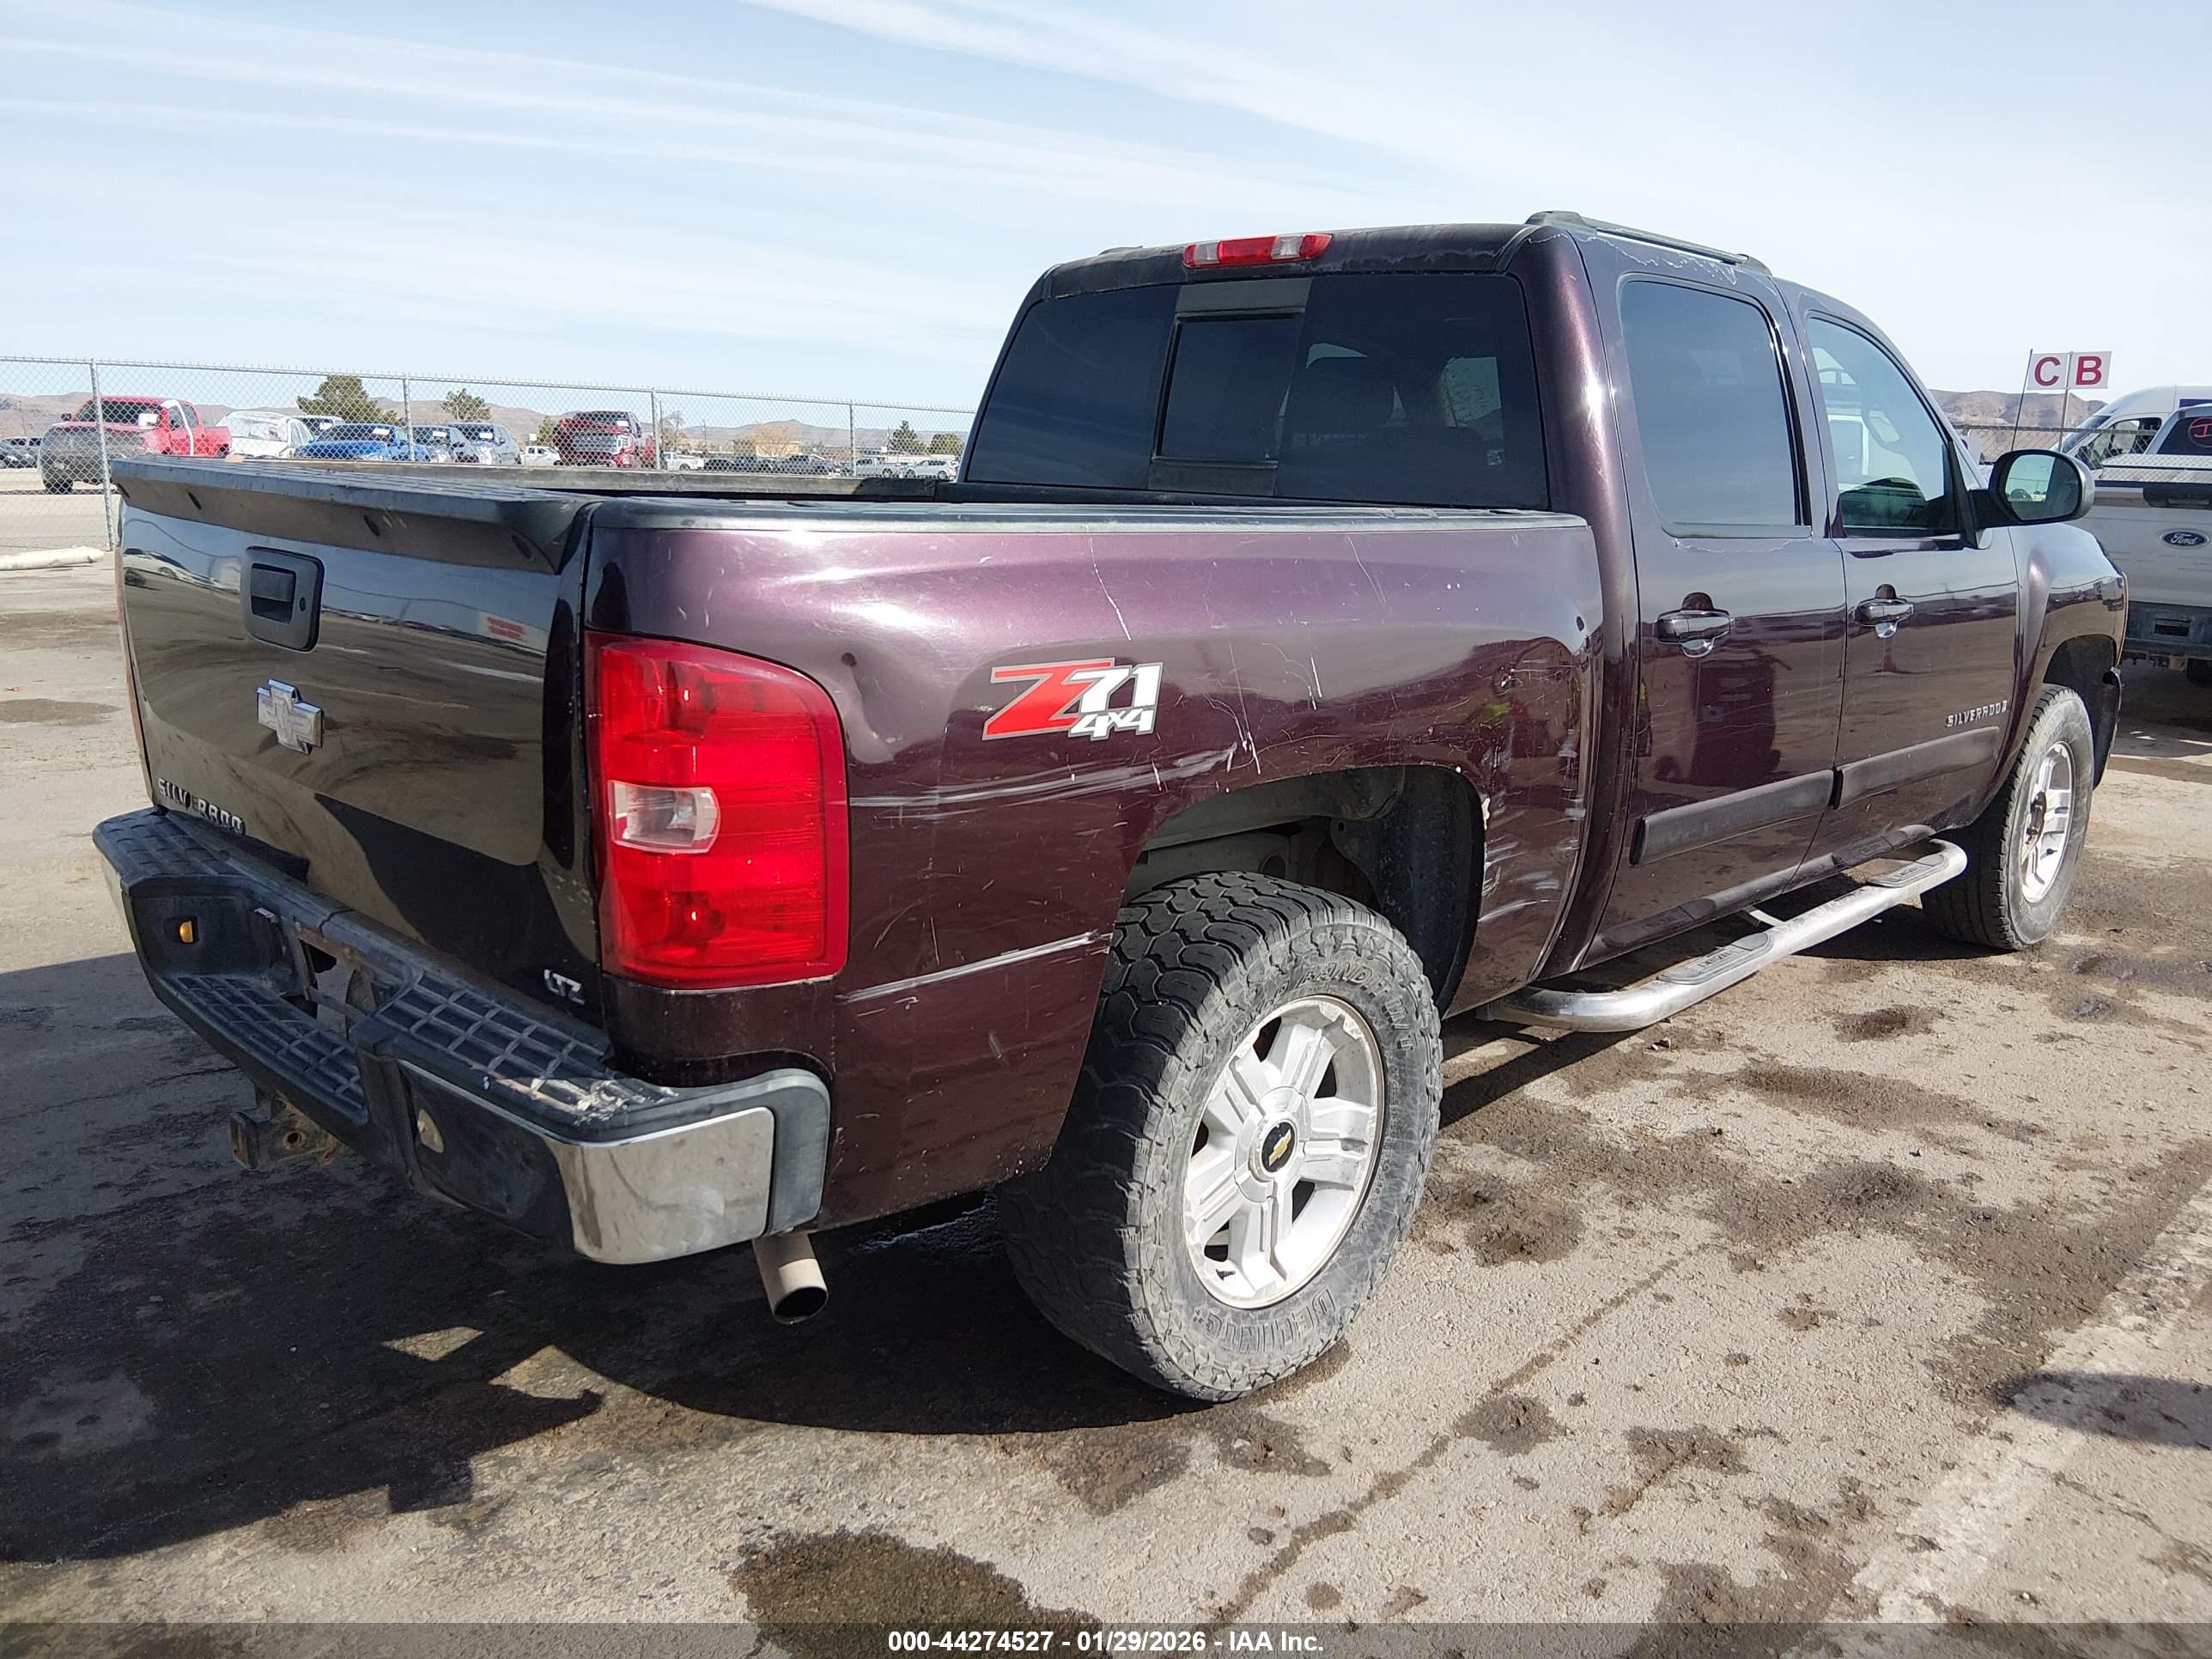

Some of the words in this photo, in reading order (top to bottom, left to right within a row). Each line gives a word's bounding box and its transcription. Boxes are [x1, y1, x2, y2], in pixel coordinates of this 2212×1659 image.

[2034, 356, 2061, 386] C
[2075, 356, 2102, 386] B
[981, 658, 1164, 741] Z71
[1946, 701, 2002, 727] SILVERADO
[157, 777, 247, 836] SILVERADO
[543, 969, 586, 1006] LTZ
